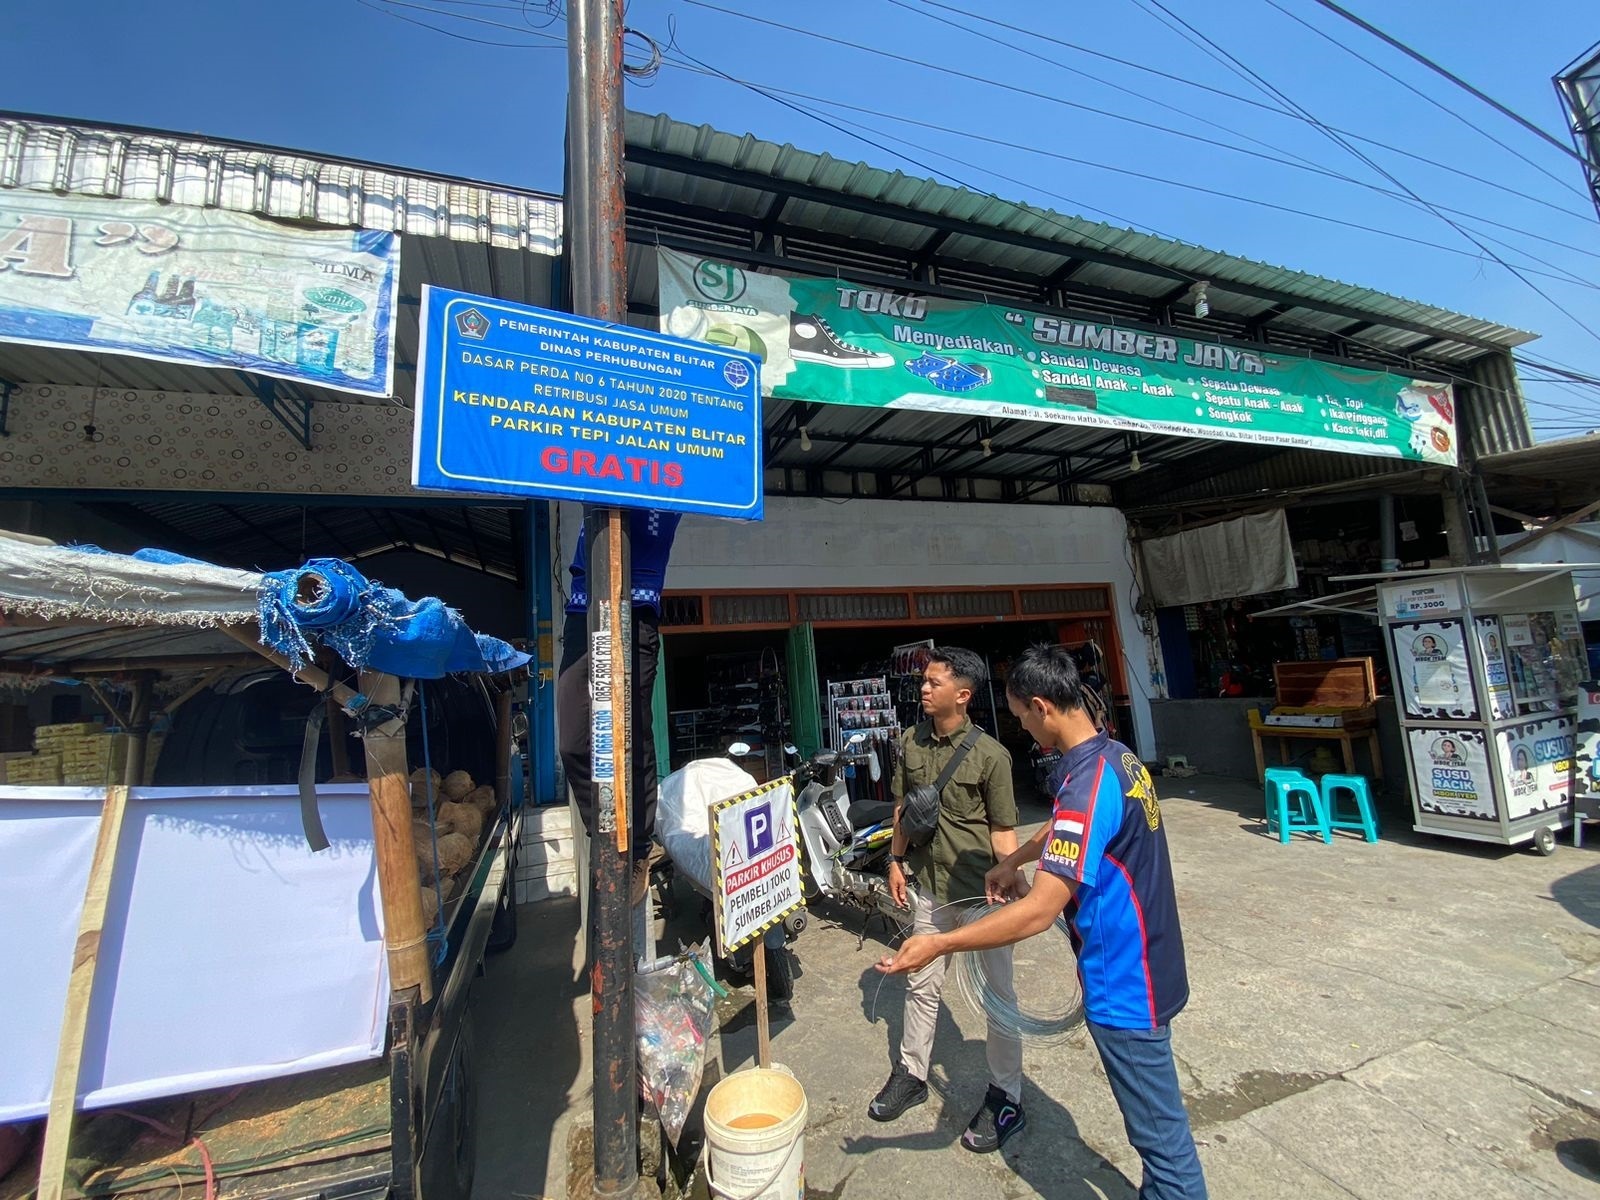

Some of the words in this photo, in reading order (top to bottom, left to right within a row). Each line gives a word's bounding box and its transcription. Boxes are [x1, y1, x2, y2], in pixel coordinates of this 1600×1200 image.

[313, 286, 357, 310] Sania
[836, 287, 927, 320] TOKO
[1032, 317, 1177, 361] SUMBER
[499, 318, 589, 344] PEMERINTAH
[594, 338, 670, 360] KABUPATEN
[674, 353, 715, 369] BLITAR
[893, 324, 1014, 357] Menyediakan
[540, 342, 581, 358] DINAS
[586, 351, 682, 377] PERHUBUNGAN
[1040, 351, 1089, 369] Sandal
[1093, 358, 1142, 377] Dewasa
[462, 351, 514, 371] DASAR
[520, 361, 570, 381] PERDA
[574, 371, 594, 385] NO
[598, 376, 605, 387] 6
[609, 378, 655, 395] TAHUN
[659, 386, 687, 401] 2020
[690, 392, 744, 412] TENTANG
[1042, 370, 1091, 387] Sandal
[1096, 376, 1129, 392] Anak
[1142, 382, 1174, 397] Anak
[1201, 376, 1238, 391] Sepatu
[1239, 382, 1281, 396] Dewasa
[534, 384, 608, 406] RETRIBUSI
[612, 398, 646, 413] JASA
[650, 404, 689, 419] UMUM
[1002, 406, 1027, 416] Alamat
[1205, 391, 1241, 406] Sepatu
[1244, 397, 1270, 410] Anak
[1280, 400, 1304, 413] Anak
[1344, 397, 1363, 410] Topi
[453, 390, 575, 420] KENDARAAN
[582, 410, 686, 437] KABUPATEN
[691, 427, 746, 445] BLITAR
[1208, 407, 1252, 423] Songkok
[1332, 421, 1354, 434] Kaos
[490, 415, 563, 437] PARKIR
[570, 426, 610, 443] TEPI
[616, 434, 670, 452] JALAN
[676, 442, 724, 459] UMUM
[540, 446, 685, 488] GRATIS
[595, 680, 612, 702] 0852
[595, 732, 613, 755] 0666
[1534, 736, 1564, 760] SUSU
[595, 759, 613, 778] 0857
[1433, 769, 1470, 780] SUSU
[1433, 779, 1474, 791] RACIK
[751, 813, 767, 849] P
[727, 868, 760, 890] PARKIR
[761, 849, 791, 874] KHUSUS
[1044, 852, 1077, 867] SAFETY
[730, 883, 769, 912] PEMBELI
[771, 868, 791, 889] TOKO
[735, 901, 772, 931] SUMBER
[773, 887, 791, 907] JAYA
